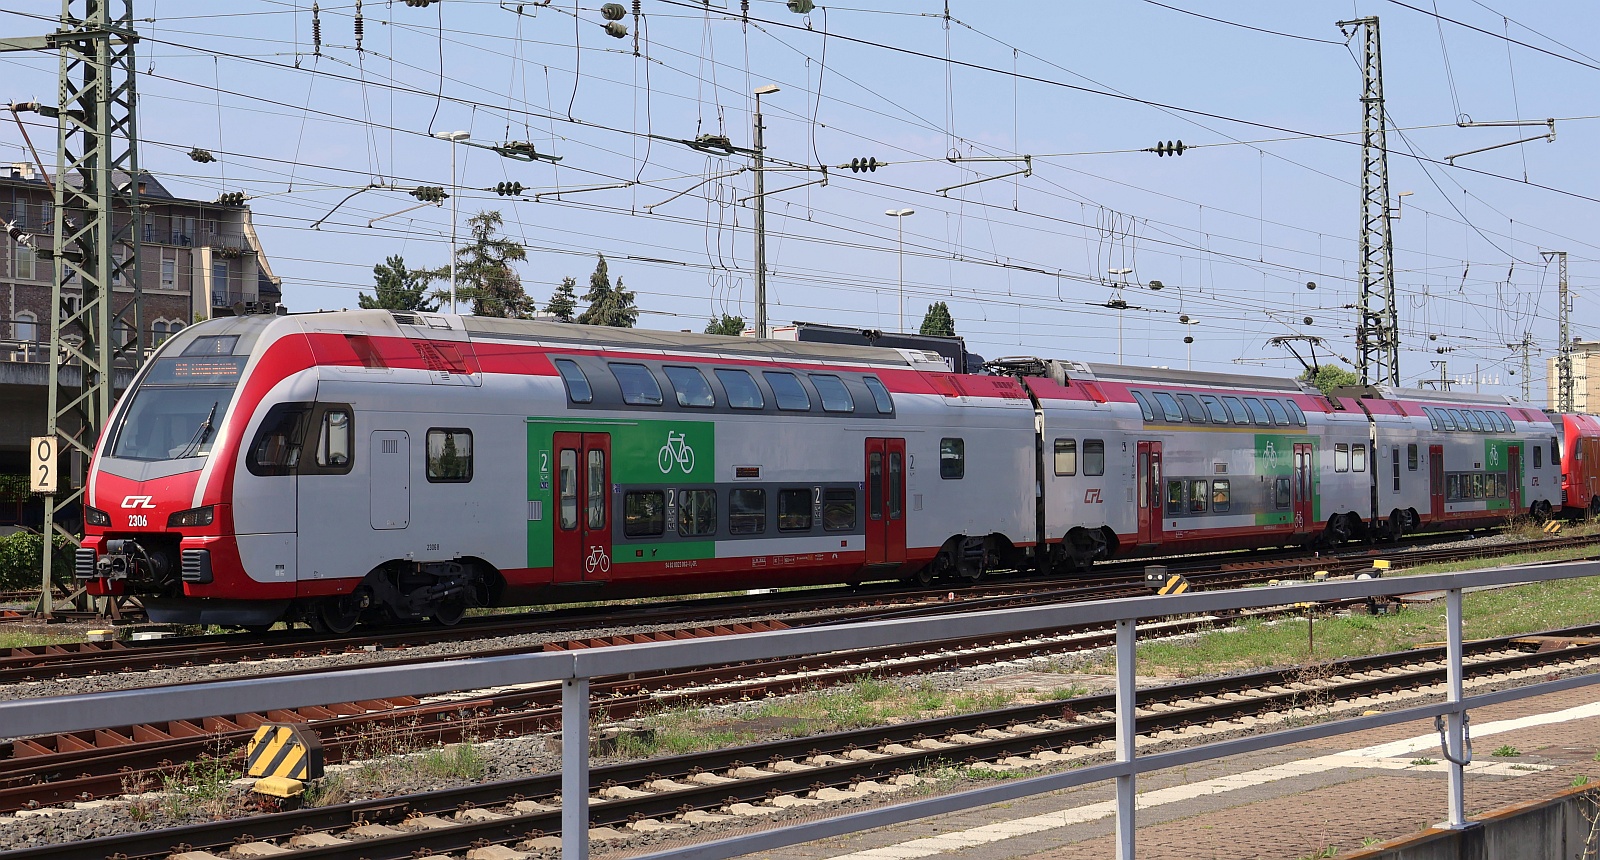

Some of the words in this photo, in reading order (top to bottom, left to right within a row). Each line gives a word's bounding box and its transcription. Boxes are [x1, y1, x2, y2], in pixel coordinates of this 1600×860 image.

[38, 440, 51, 462] 0
[541, 453, 548, 472] 2
[909, 454, 915, 470] 2
[38, 464, 49, 486] 2
[120, 495, 157, 509] CFL
[668, 489, 675, 507] 2
[815, 487, 821, 504] 2
[1084, 488, 1104, 504] CFL
[128, 514, 148, 527] 2306
